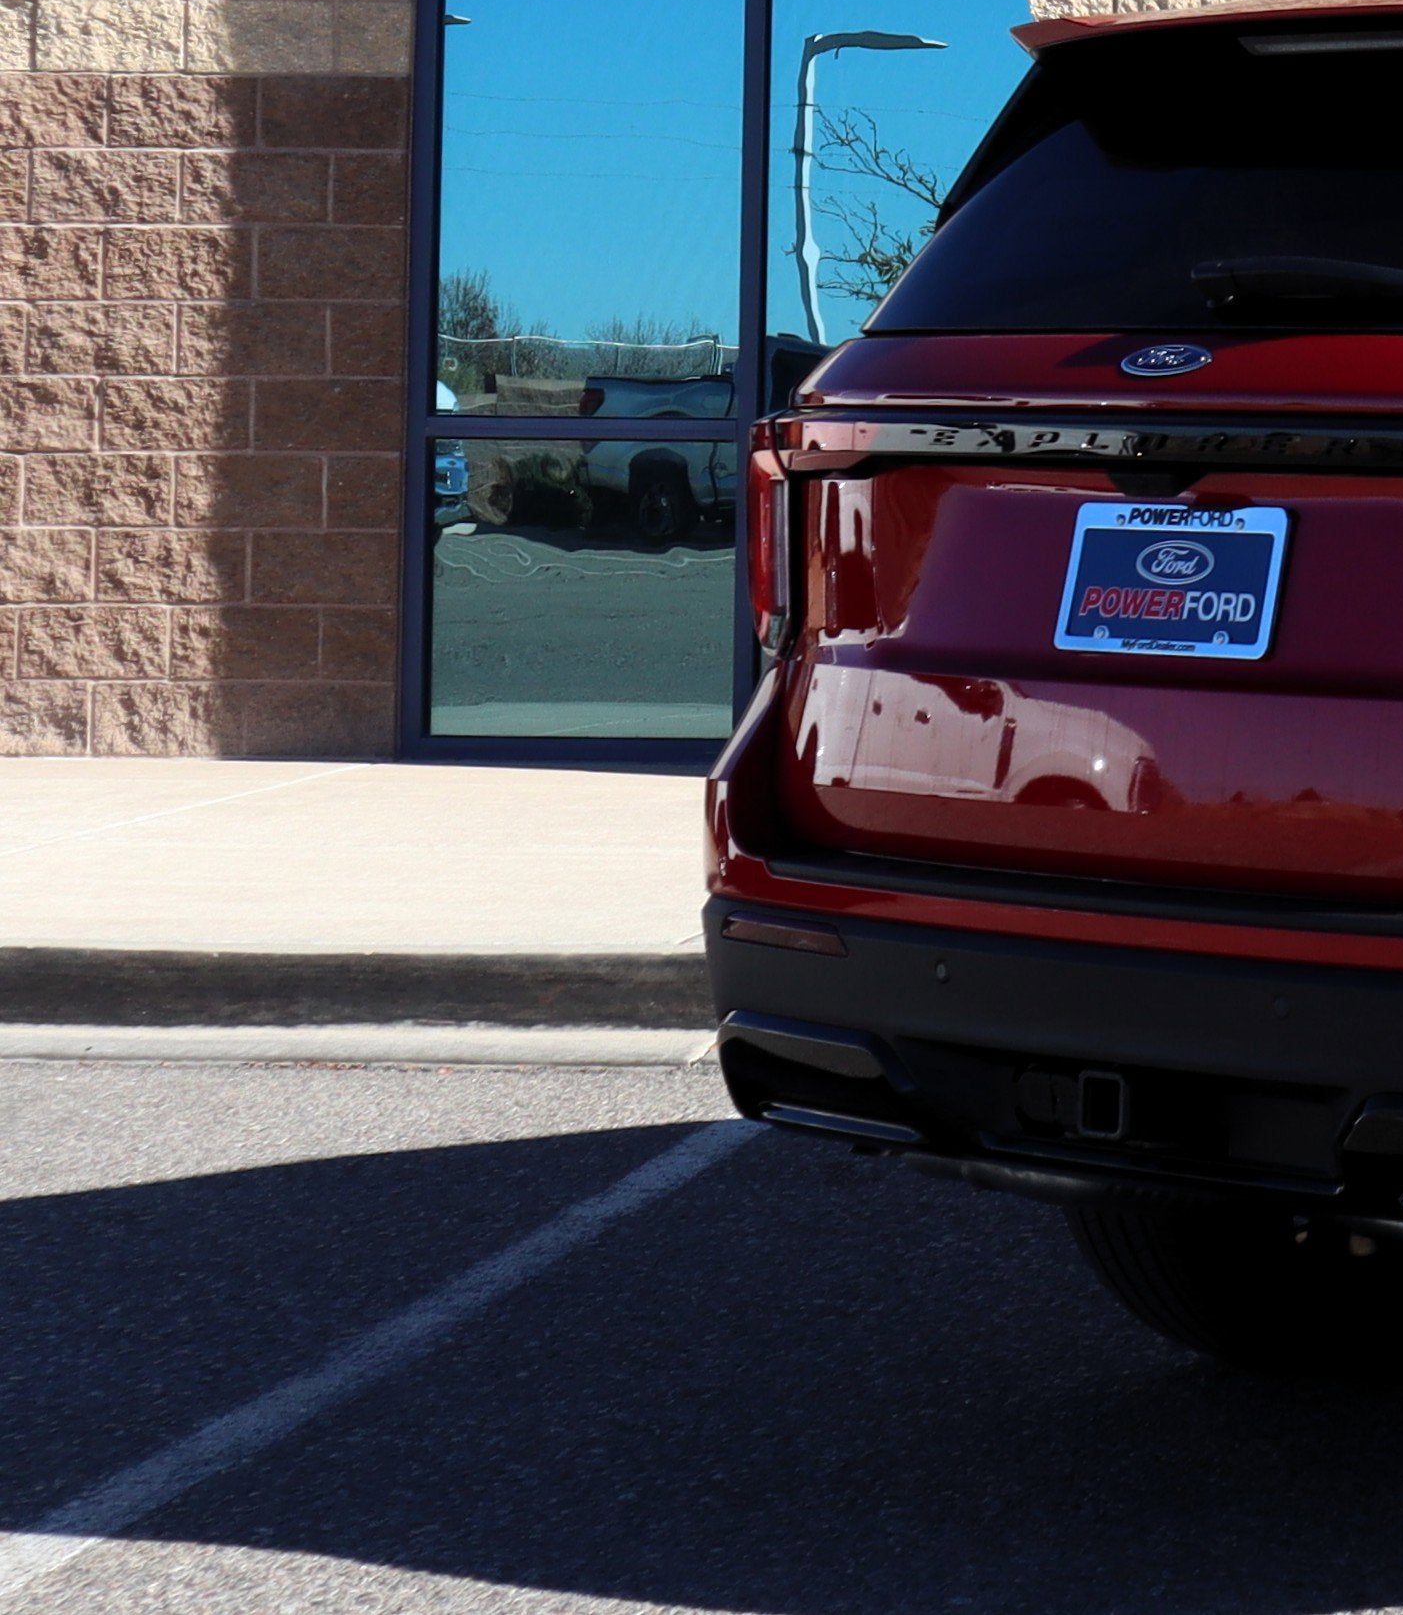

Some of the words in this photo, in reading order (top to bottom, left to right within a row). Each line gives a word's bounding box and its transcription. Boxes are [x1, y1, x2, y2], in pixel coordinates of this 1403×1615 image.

[1128, 507, 1234, 528] POWERFORD
[1152, 547, 1200, 575] Ford
[1079, 586, 1256, 623] POWERFORD
